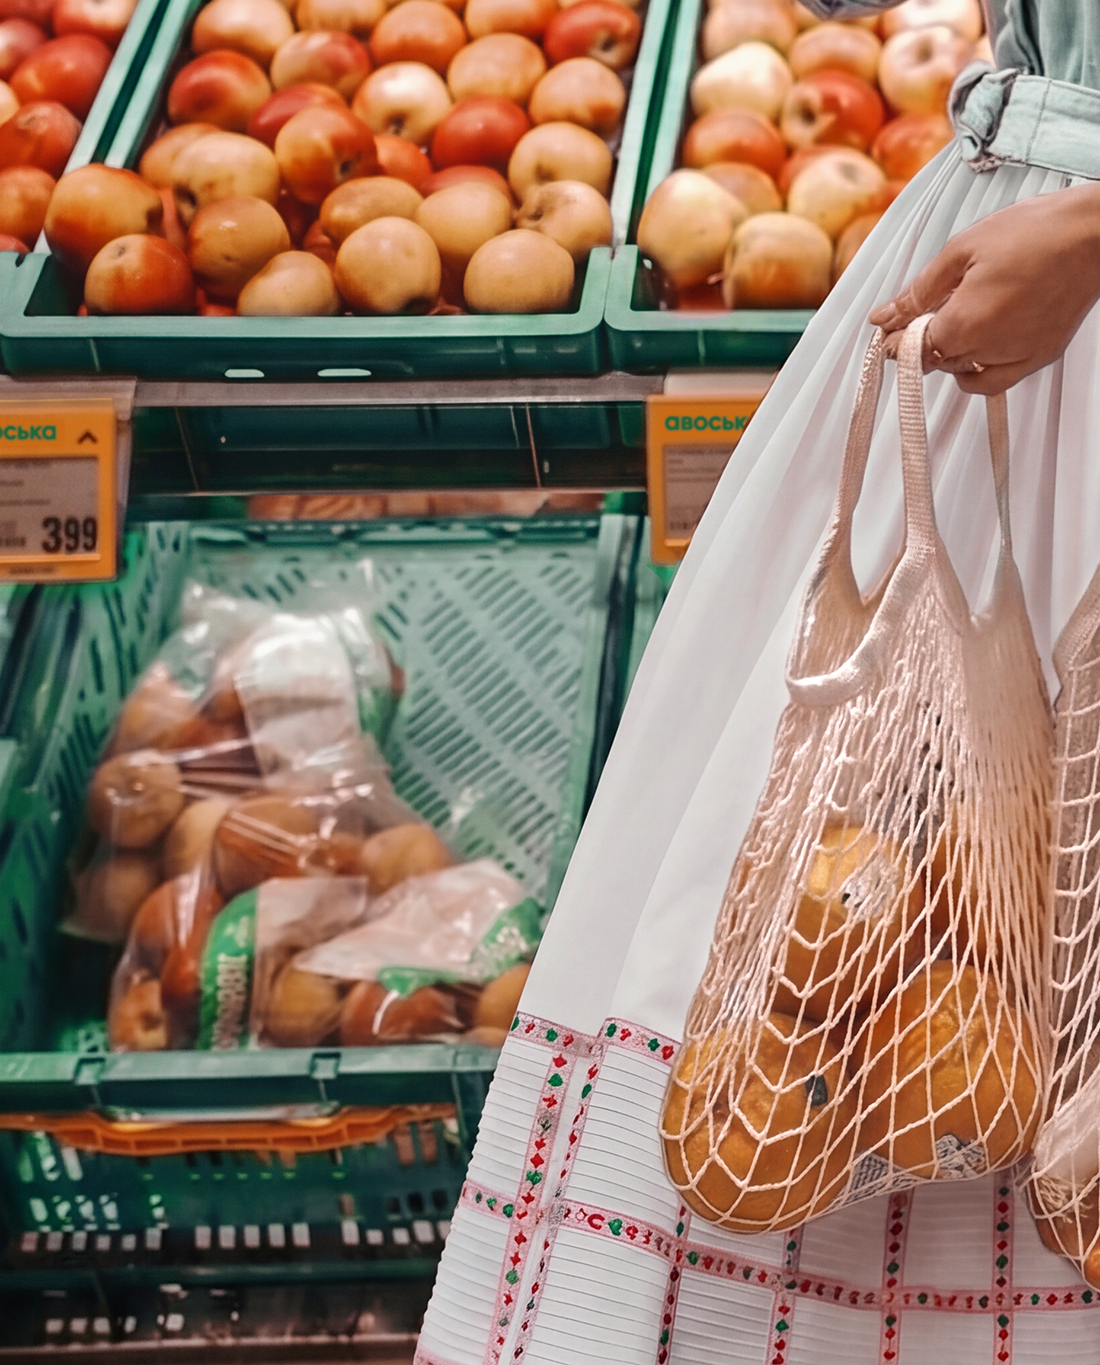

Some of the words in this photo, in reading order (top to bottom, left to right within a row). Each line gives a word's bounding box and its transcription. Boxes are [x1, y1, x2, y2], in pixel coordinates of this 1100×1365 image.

[664, 415, 749, 432] авоськ
[0, 424, 57, 441] ська
[42, 516, 98, 554] 399
